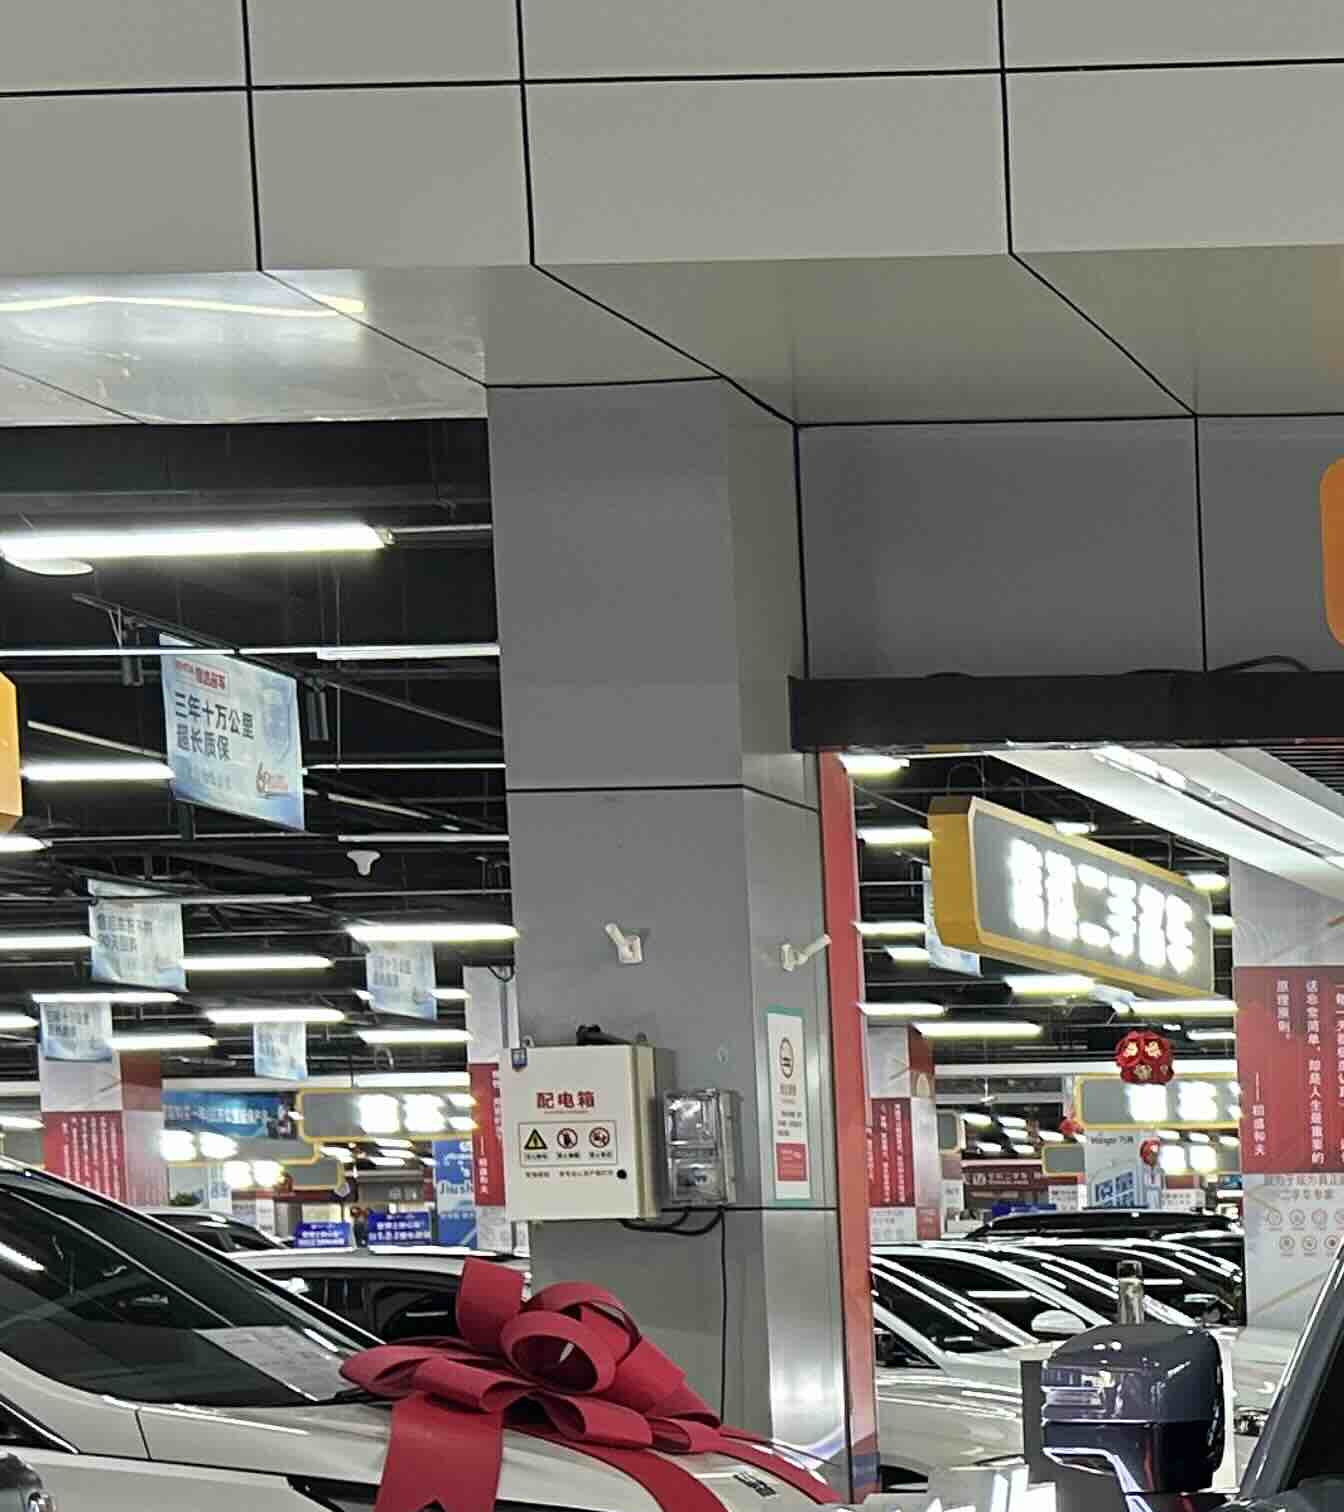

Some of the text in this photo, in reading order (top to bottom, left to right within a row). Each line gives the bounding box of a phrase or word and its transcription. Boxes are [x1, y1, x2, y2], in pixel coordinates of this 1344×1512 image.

[175, 691, 255, 740] 三年十万公里
[536, 1091, 594, 1109] 配电箱
